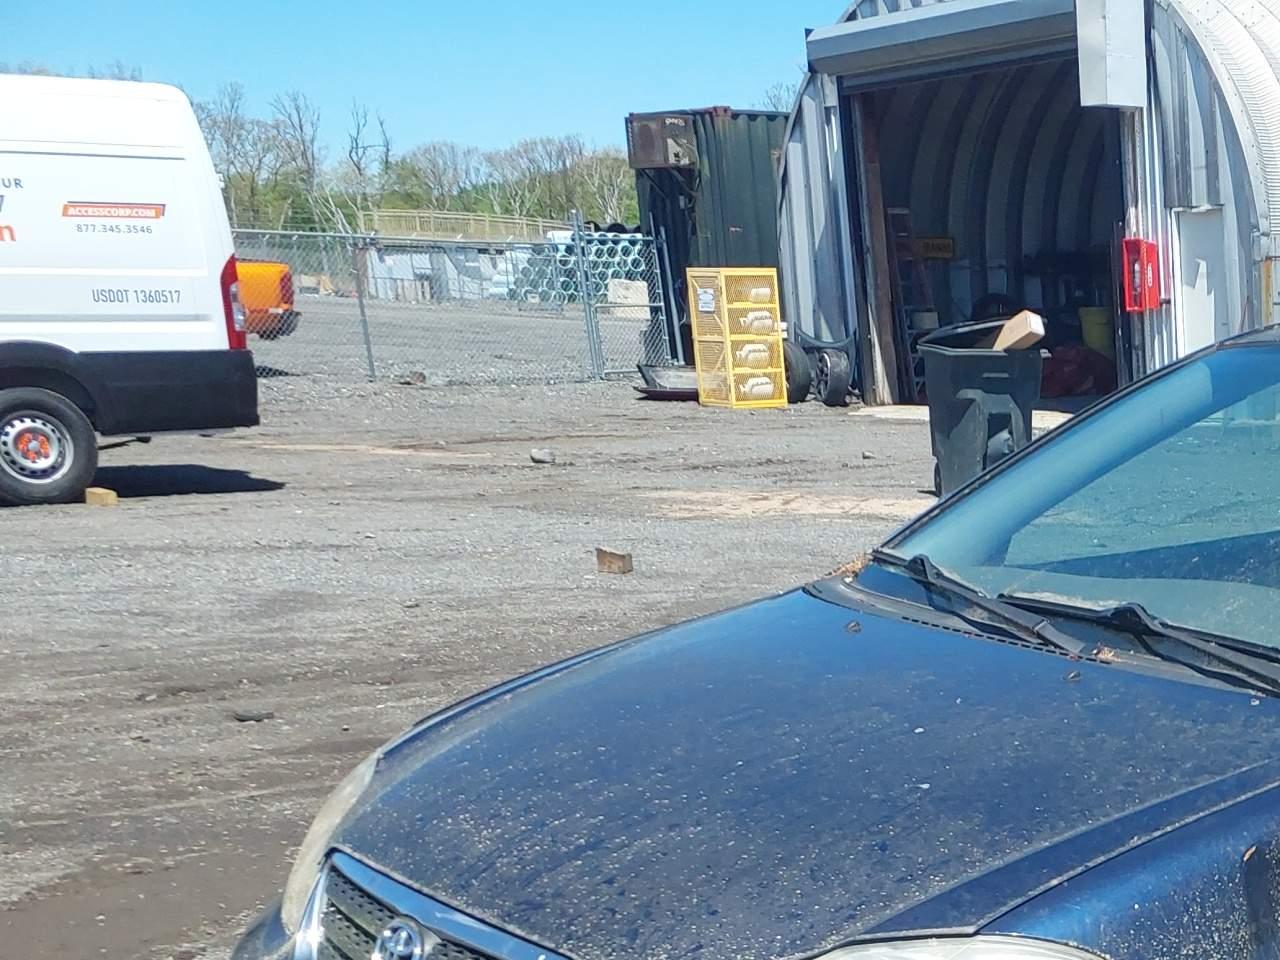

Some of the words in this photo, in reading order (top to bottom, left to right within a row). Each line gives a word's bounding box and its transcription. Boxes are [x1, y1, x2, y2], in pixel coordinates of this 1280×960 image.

[68, 207, 156, 218] ACCESSCORP.COM
[76, 224, 153, 234] 877.345.3546
[92, 289, 130, 303] USDOT
[134, 289, 181, 303] 1360517
